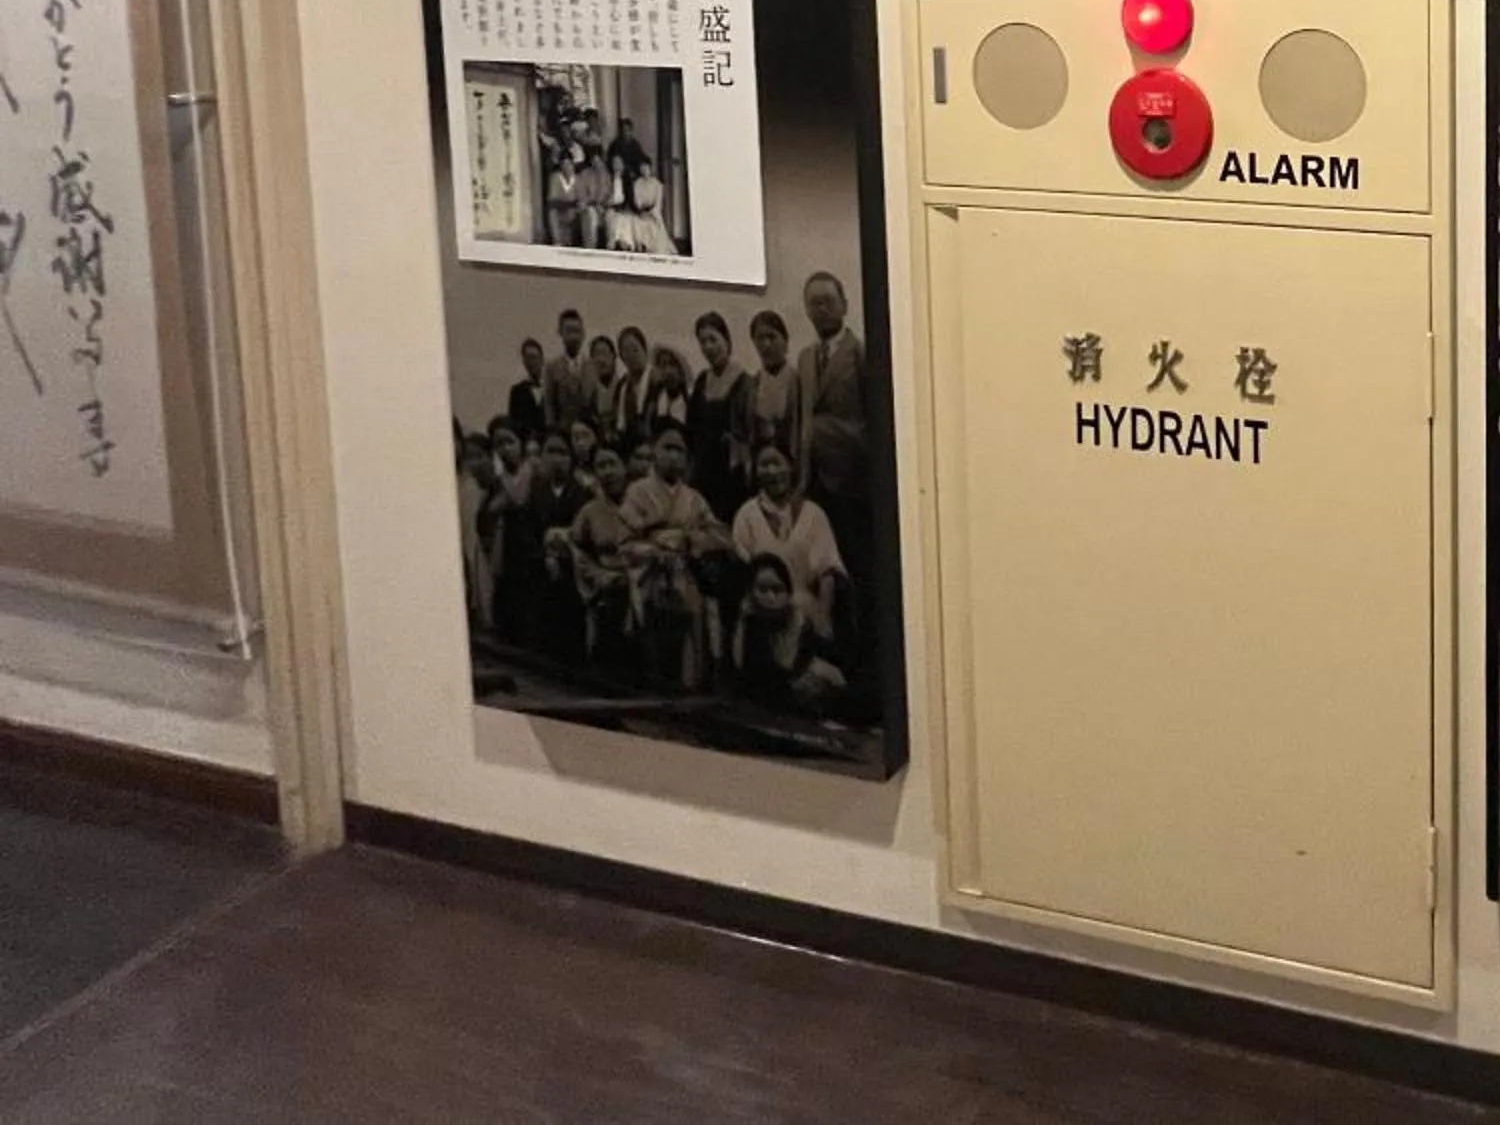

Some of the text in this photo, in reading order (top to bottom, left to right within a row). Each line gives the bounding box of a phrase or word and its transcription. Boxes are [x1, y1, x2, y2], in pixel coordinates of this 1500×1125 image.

[1219, 151, 1360, 190] ALARM
[1062, 332, 1278, 405] 消火栓
[1075, 402, 1269, 465] HYDRANT
